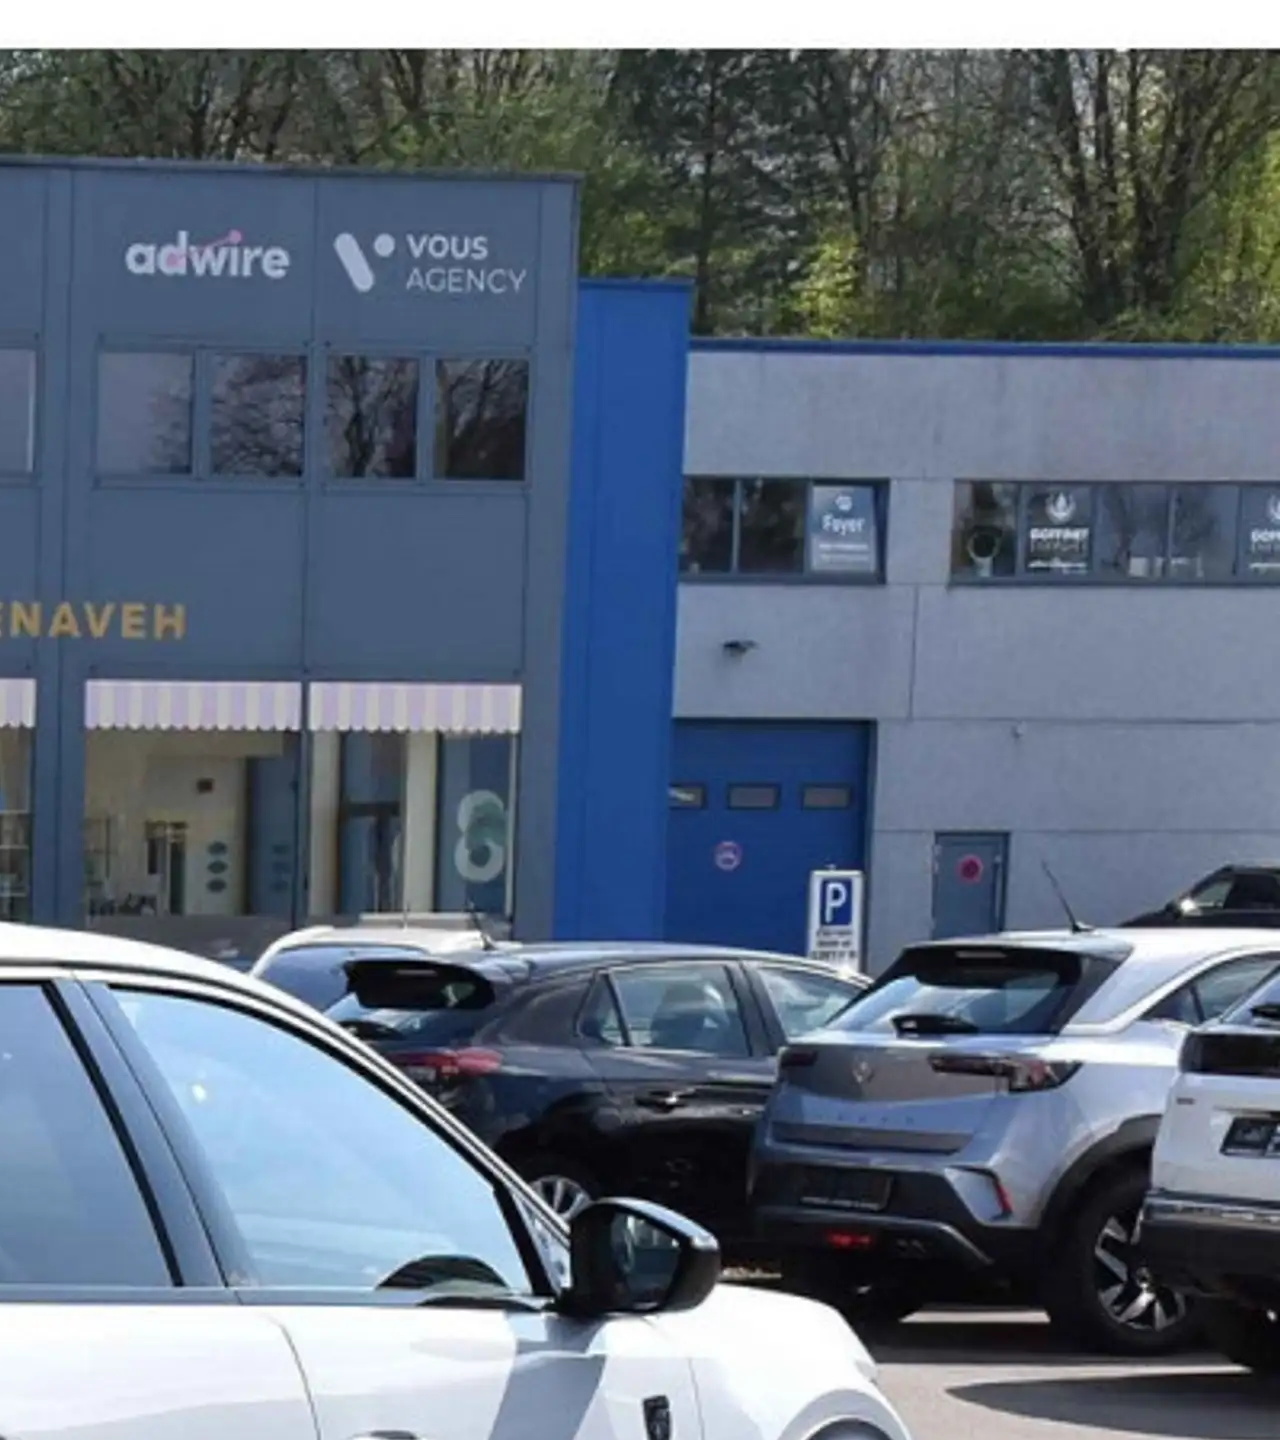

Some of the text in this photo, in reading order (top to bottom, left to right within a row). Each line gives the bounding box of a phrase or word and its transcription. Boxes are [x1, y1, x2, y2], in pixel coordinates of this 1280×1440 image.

[125, 230, 291, 279] adwire
[405, 233, 489, 260] VOUS
[405, 267, 527, 294] AGENCY
[824, 882, 847, 923] P
